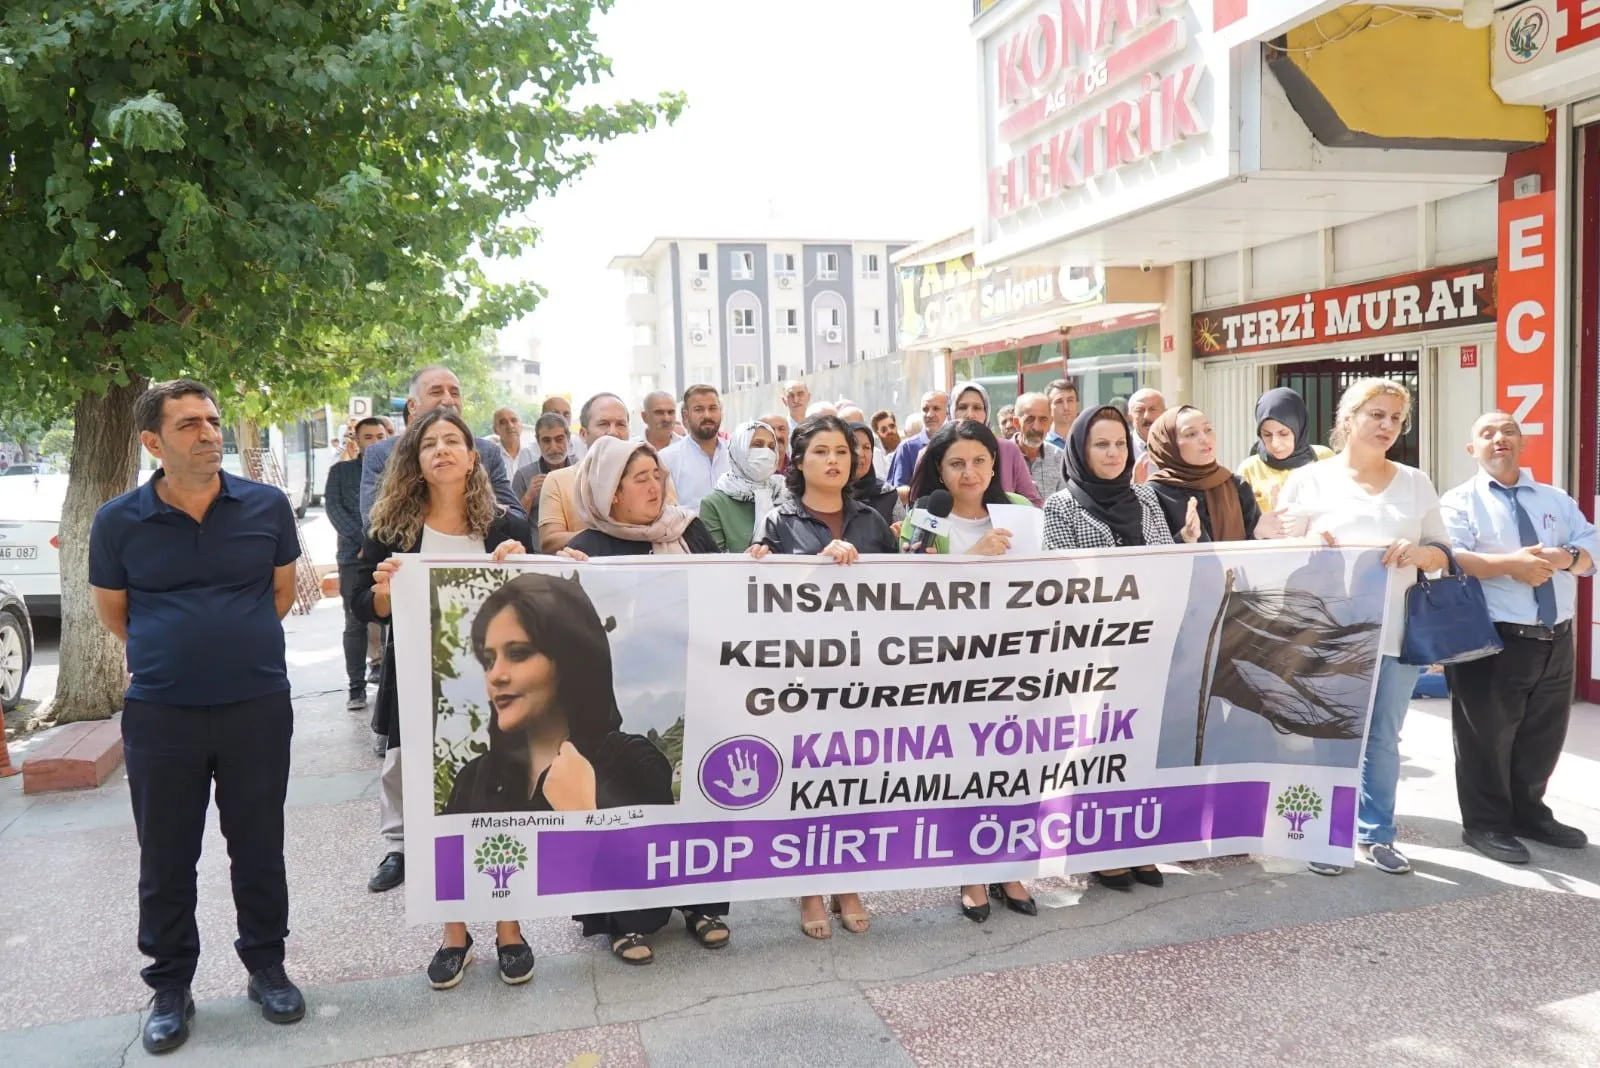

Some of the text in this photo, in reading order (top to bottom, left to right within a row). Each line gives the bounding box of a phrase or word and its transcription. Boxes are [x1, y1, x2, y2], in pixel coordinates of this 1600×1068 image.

[1044, 85, 1066, 117] AG
[988, 64, 1199, 220] ELEKTRİK
[981, 273, 1053, 318] Salonu
[1222, 273, 1484, 348] TERZİ MURAT
[1505, 214, 1545, 485] ECZ
[354, 400, 366, 414] D
[16, 547, 35, 558] 087
[747, 574, 1140, 613] İNSANLARI ZORLA
[719, 618, 1154, 668] KENDİ CENNETİNİZE
[745, 662, 1119, 717] GÖTÜREMEZSİNİZ
[791, 703, 1138, 769] KADINA YÖNELİK
[790, 753, 1127, 811] KATLİAMLARA HAYIR
[471, 815, 565, 829] #MashaAmini
[647, 797, 1162, 881] HDP SİİRT İL ÖRGÜTÜ
[1288, 832, 1304, 840] HDP
[492, 890, 511, 899] HDP
